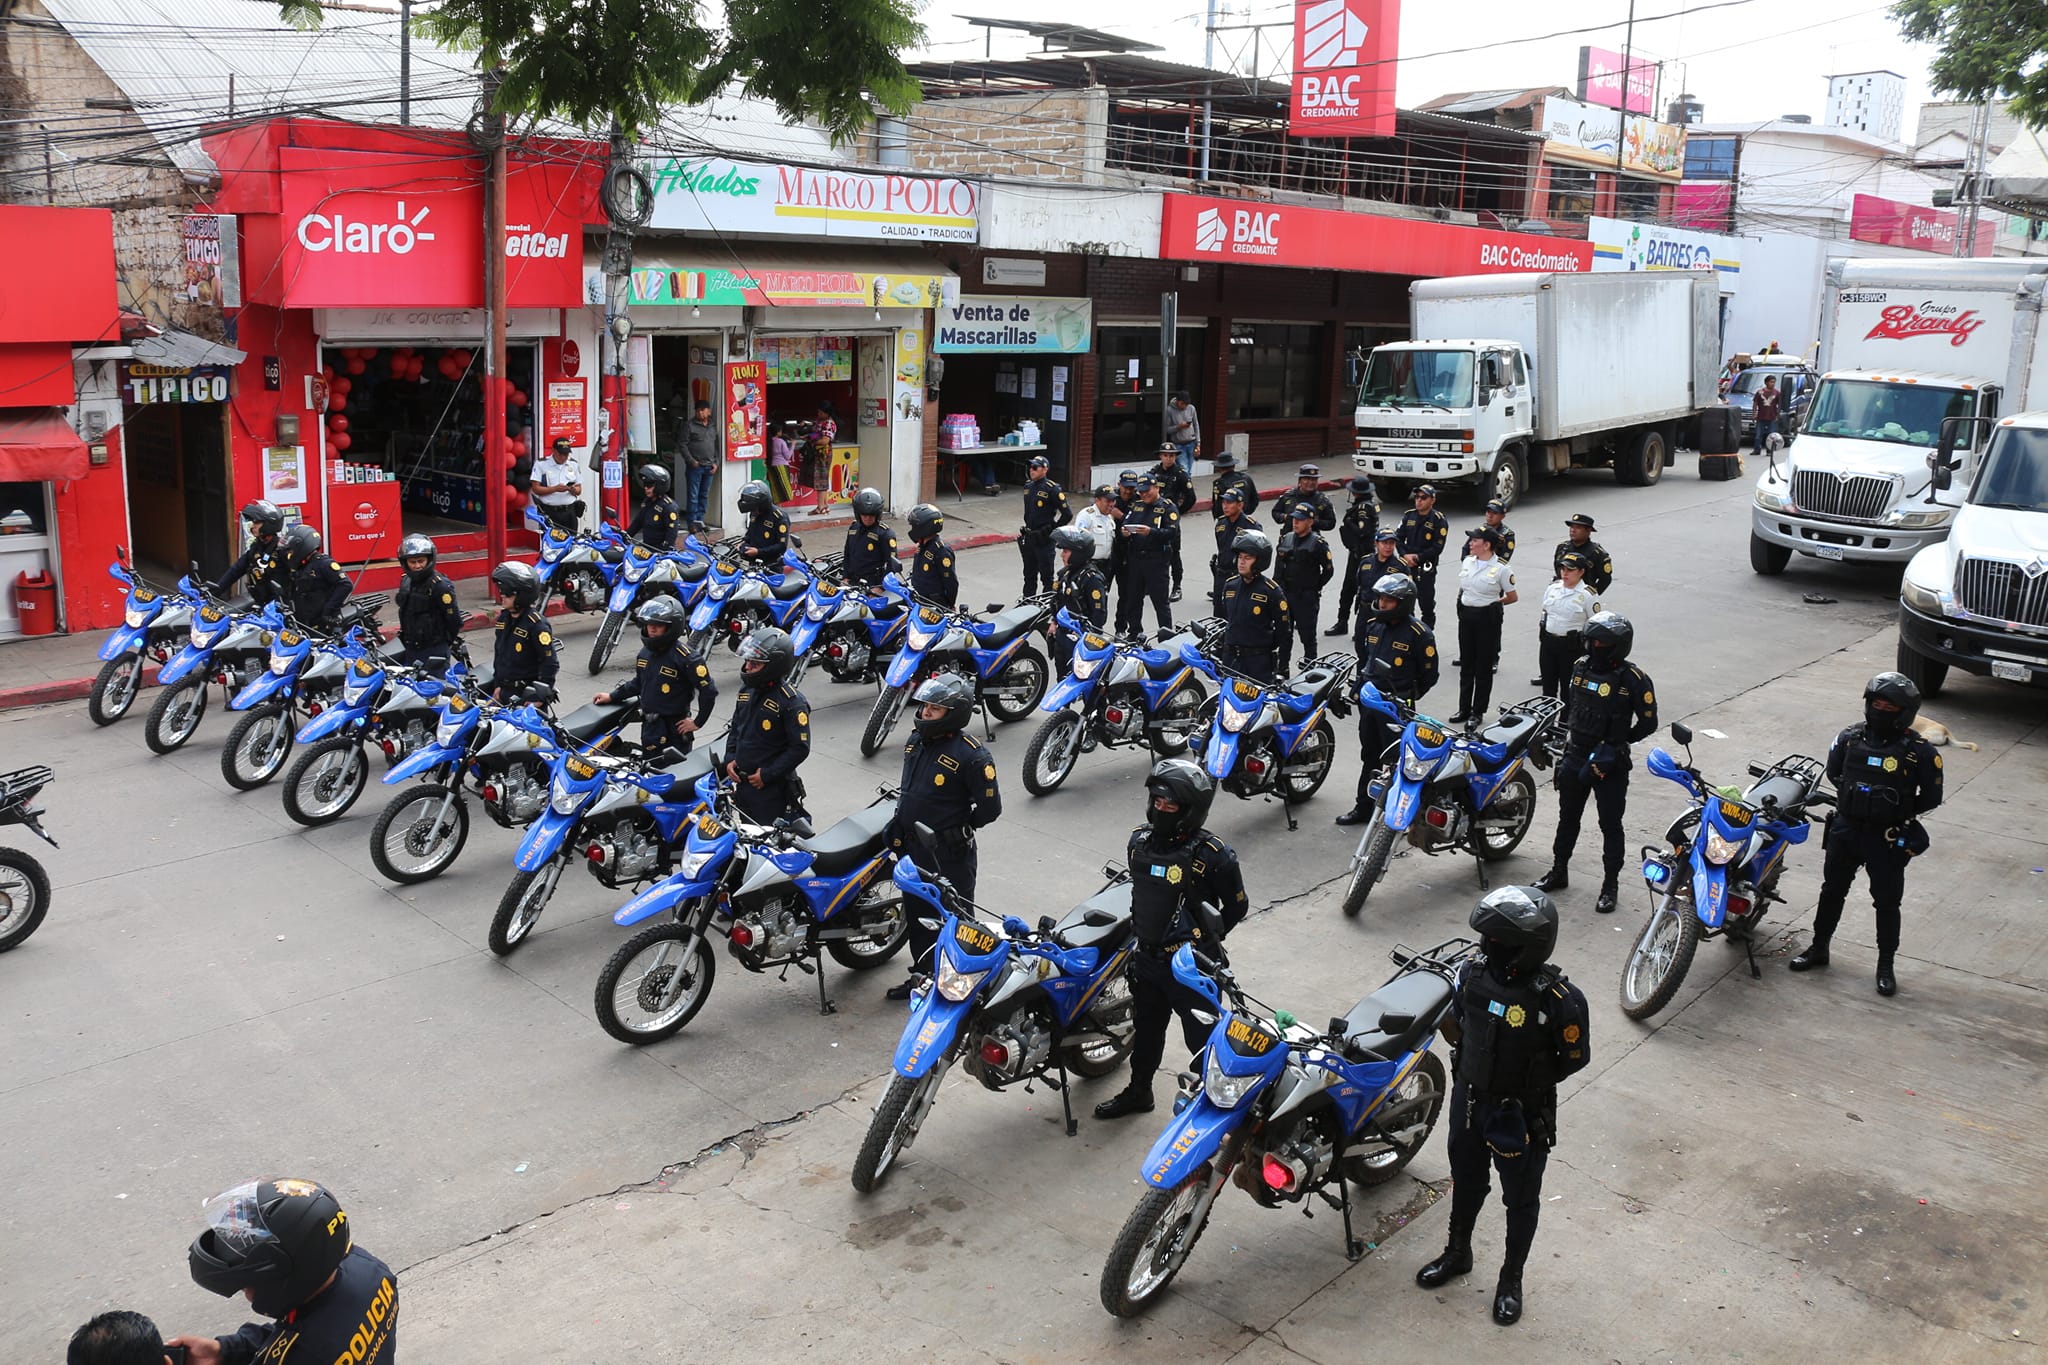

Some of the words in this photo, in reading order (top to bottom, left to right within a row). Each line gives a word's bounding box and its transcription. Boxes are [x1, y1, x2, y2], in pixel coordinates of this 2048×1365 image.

[1302, 75, 1361, 107] BAC
[1605, 68, 1651, 97] BATRAB
[1300, 106, 1359, 118] CREDOMATIC
[655, 158, 761, 197] Helados
[775, 166, 875, 210] MARCO
[884, 174, 976, 217] POLO
[297, 213, 416, 255] Claro
[881, 225, 918, 237] CALIDAD
[928, 228, 973, 240] TRADICION
[1232, 208, 1280, 244] BAC
[1920, 219, 1953, 242] BANTRAB
[1232, 242, 1278, 257] CREDOMATIC
[1481, 244, 1508, 266] BAC
[1510, 246, 1580, 272] Credomatic
[1646, 239, 1693, 269] BATRES
[710, 271, 761, 291] Helados
[765, 272, 813, 292] MARCO
[816, 273, 865, 293] POLO
[952, 303, 1004, 322] Venta
[1008, 303, 1031, 322] de
[1920, 300, 1957, 316] Grupo
[940, 325, 1037, 346] Mascarillas
[129, 375, 229, 404] TIPICO
[1388, 428, 1423, 438] ISUZU
[354, 511, 375, 521] Claro
[348, 533, 366, 541] Claro
[956, 924, 996, 952] SNM-182
[1227, 1020, 1272, 1053] SNM-178
